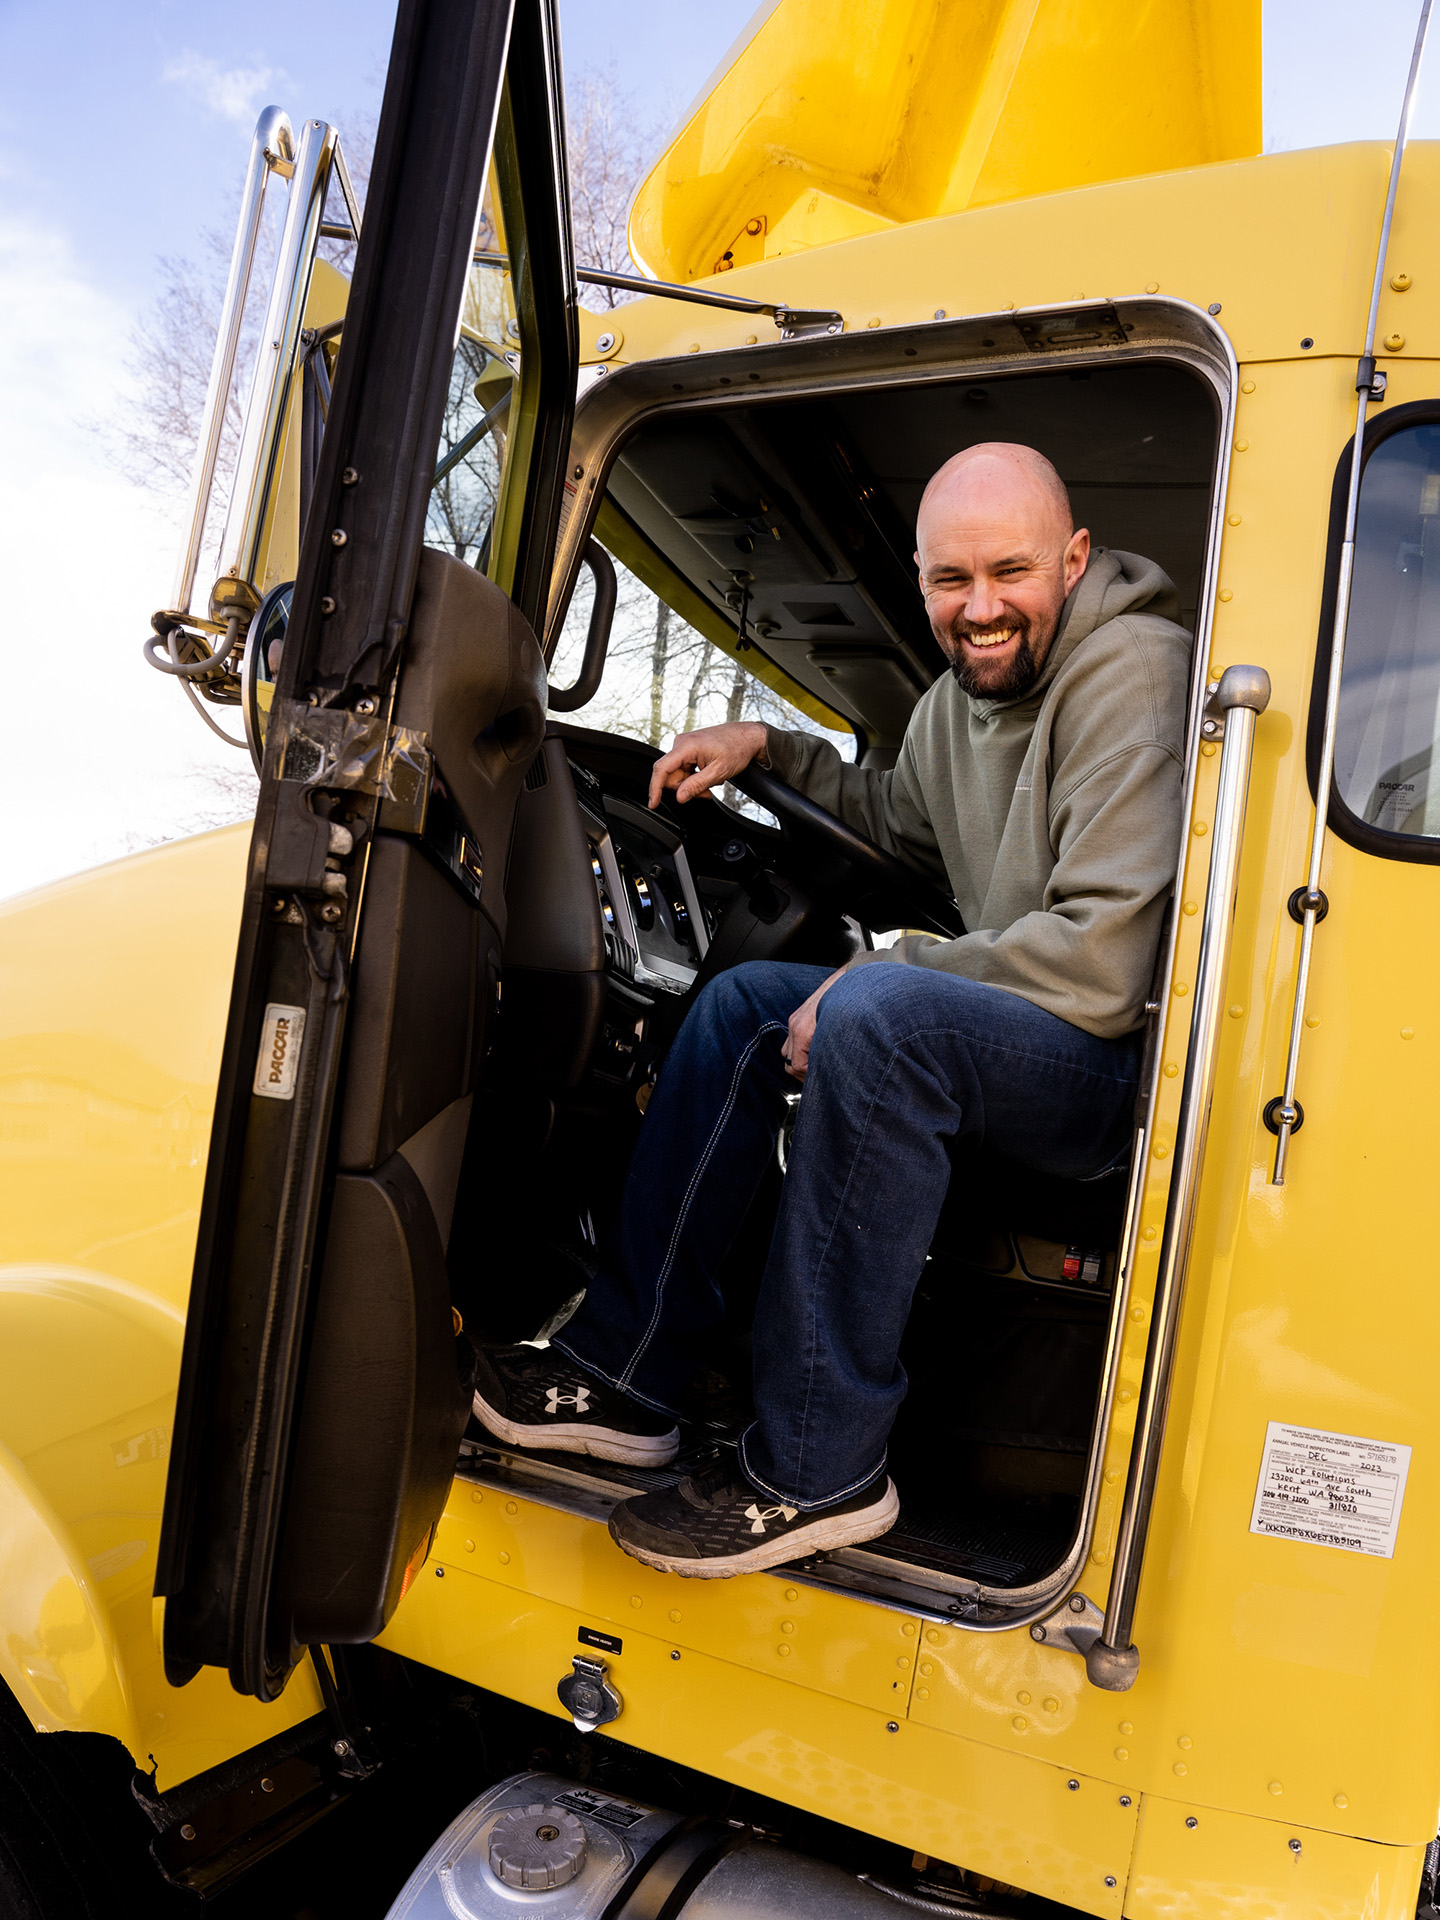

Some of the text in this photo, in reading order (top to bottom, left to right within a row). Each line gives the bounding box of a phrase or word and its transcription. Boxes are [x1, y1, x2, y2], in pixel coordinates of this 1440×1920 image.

[1379, 782, 1415, 792] PACCAR
[269, 1018, 290, 1084] PACCAR
[1309, 1445, 1336, 1454] INSPECTION
[1309, 1451, 1327, 1461] DEC
[1286, 1466, 1305, 1475] WCP
[1361, 1463, 1381, 1473] 2023
[1325, 1484, 1340, 1492] Ave
[1346, 1486, 1371, 1497] South
[1309, 1490, 1324, 1498] WA
[1328, 1491, 1355, 1503] 98032
[1329, 1502, 1357, 1513] 311820
